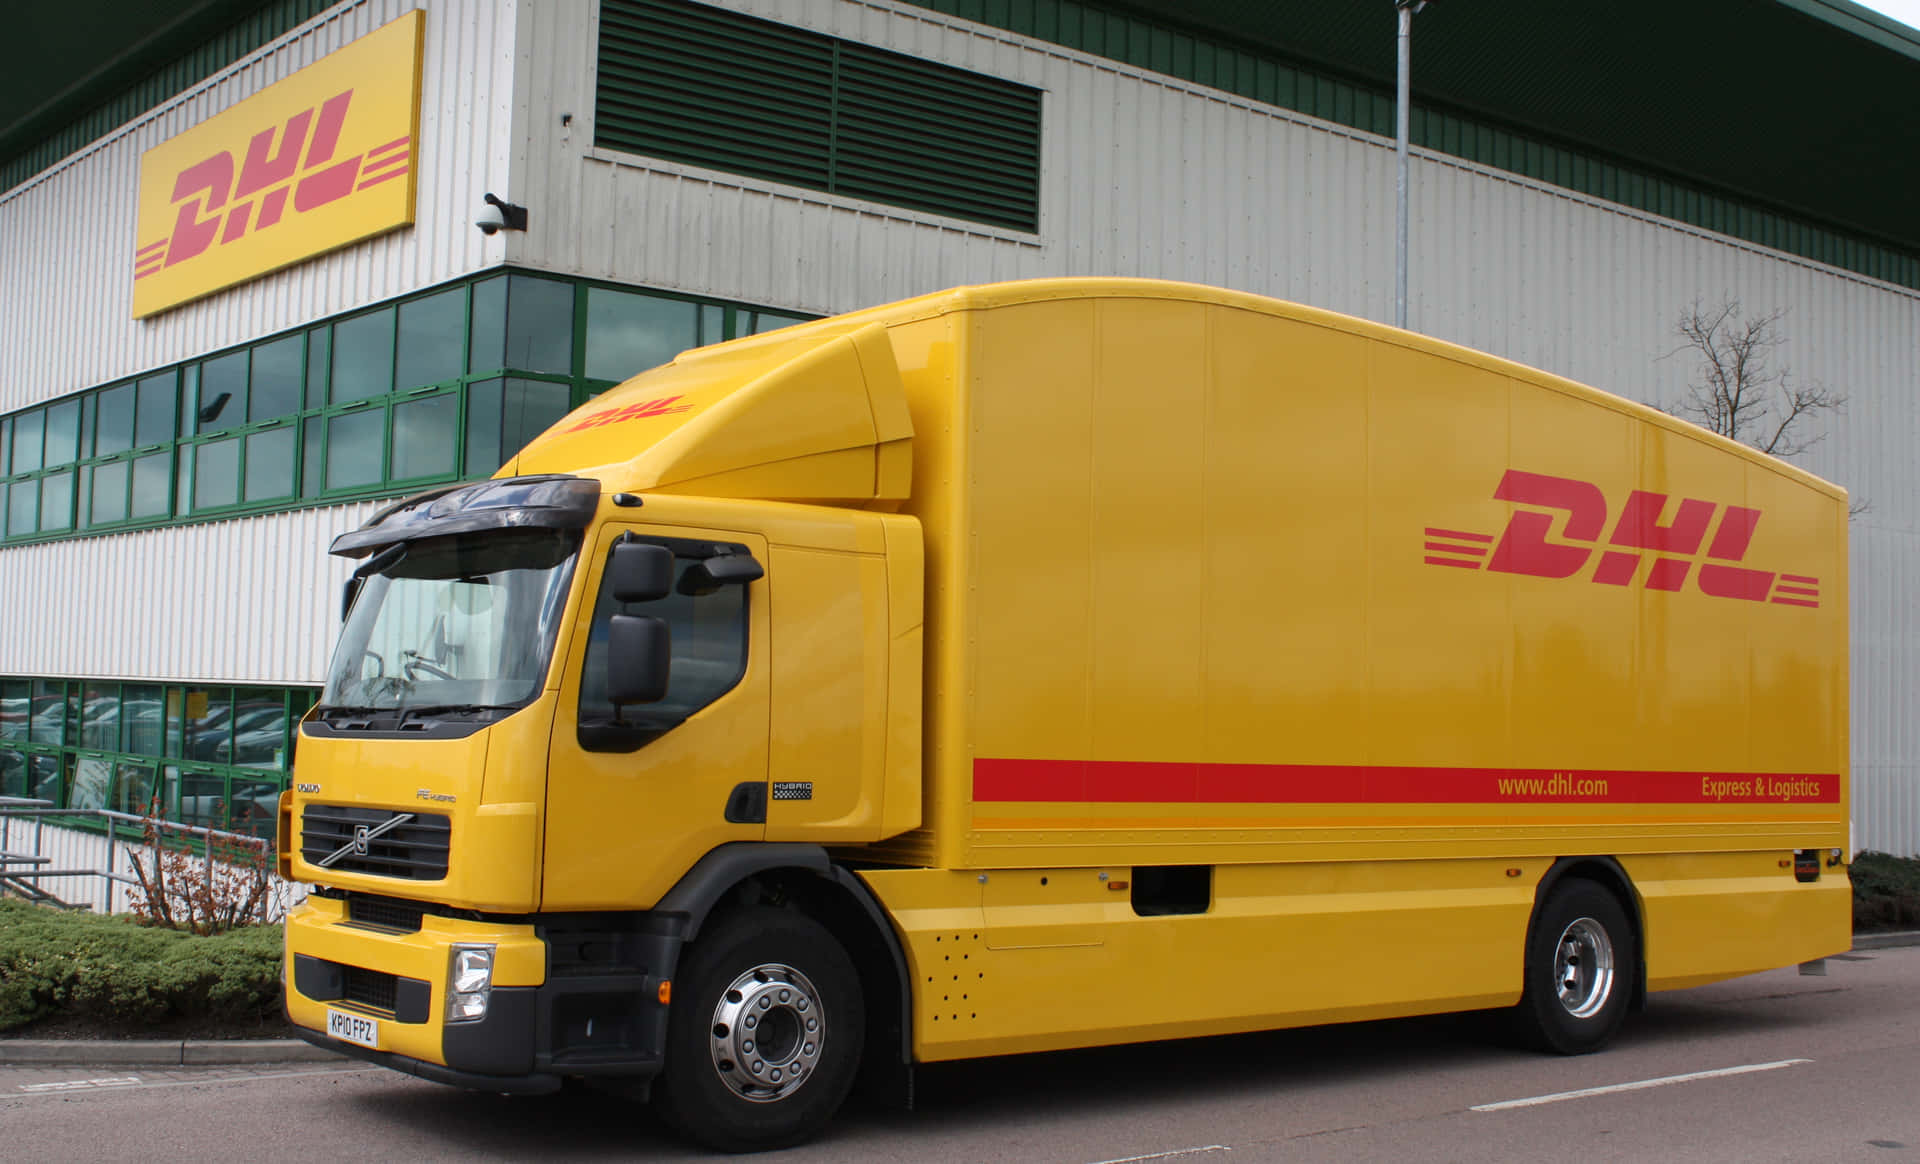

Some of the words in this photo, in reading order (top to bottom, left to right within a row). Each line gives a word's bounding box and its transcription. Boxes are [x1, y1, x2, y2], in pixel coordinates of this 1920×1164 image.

[164, 88, 364, 269] DHL
[564, 394, 684, 434] DHL
[1487, 469, 1776, 602] DHL
[1498, 772, 1608, 796] www.dhl.com
[1702, 776, 1751, 801] Express
[1755, 777, 1765, 796] &
[1768, 777, 1820, 801] Logistics
[331, 1012, 352, 1036] KP10
[353, 1018, 371, 1041] FPZ
